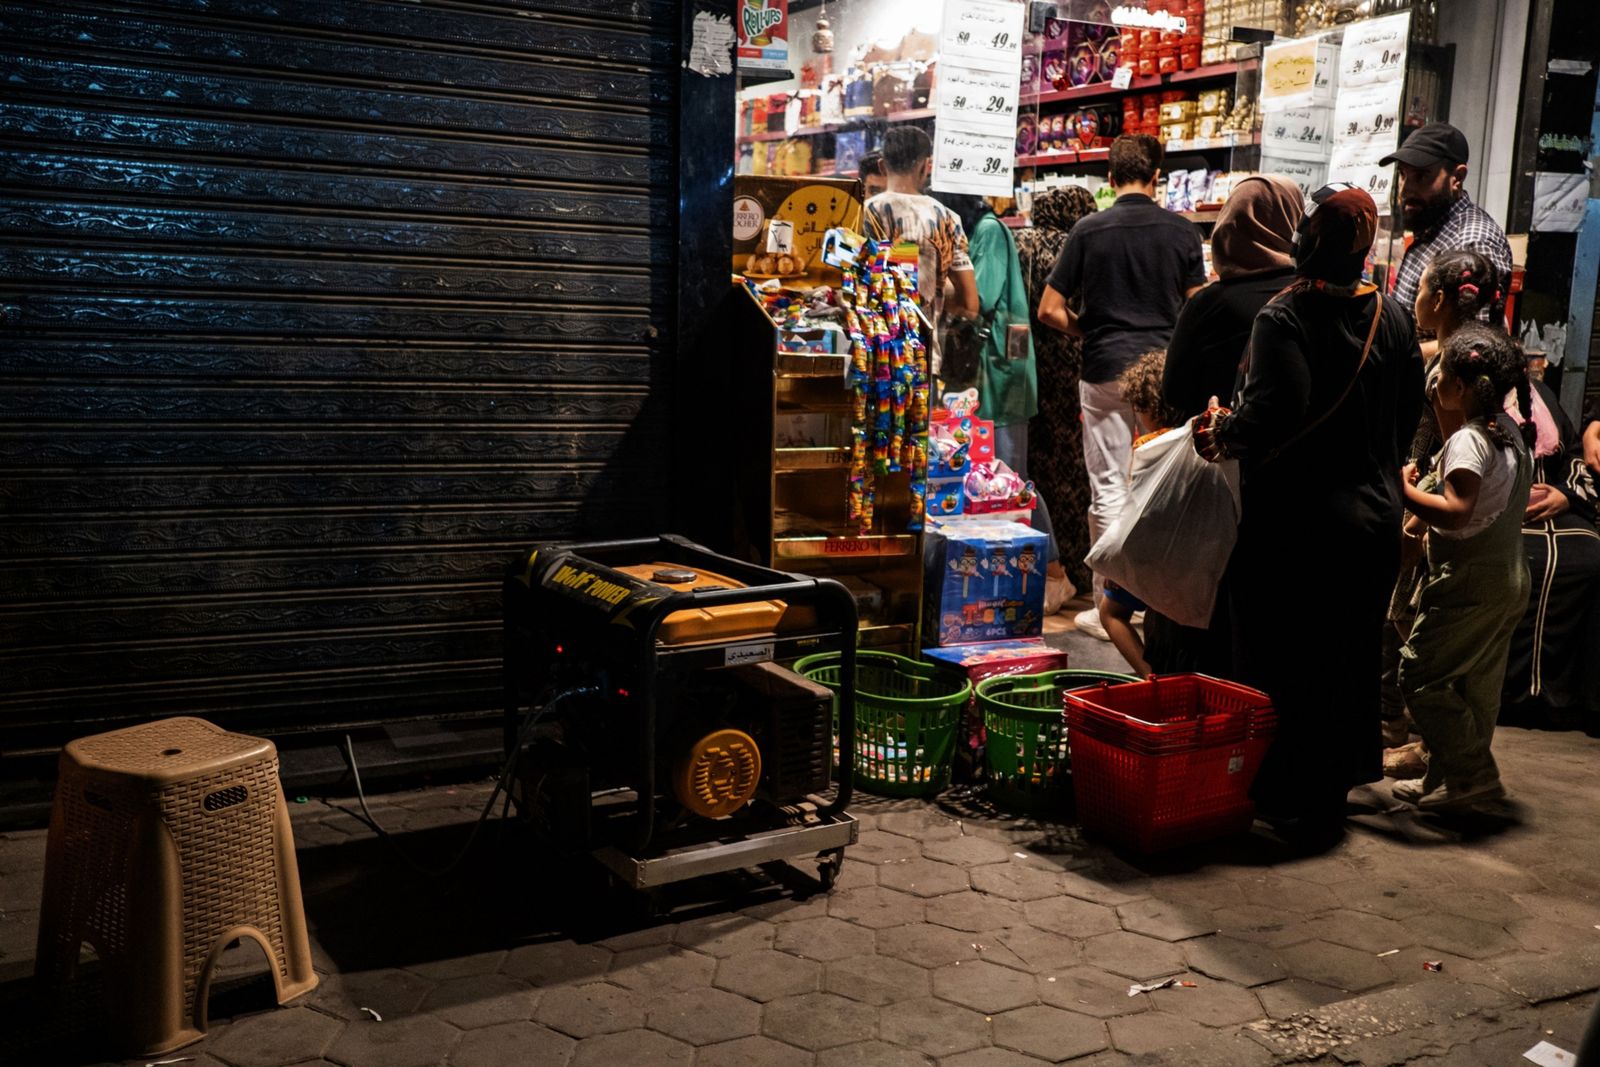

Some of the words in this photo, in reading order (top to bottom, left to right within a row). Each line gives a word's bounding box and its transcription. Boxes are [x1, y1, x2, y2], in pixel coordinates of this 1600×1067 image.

[953, 95, 967, 108] 50
[949, 157, 963, 170] 50
[824, 541, 869, 553] FERRERO
[584, 579, 631, 605] POWER
